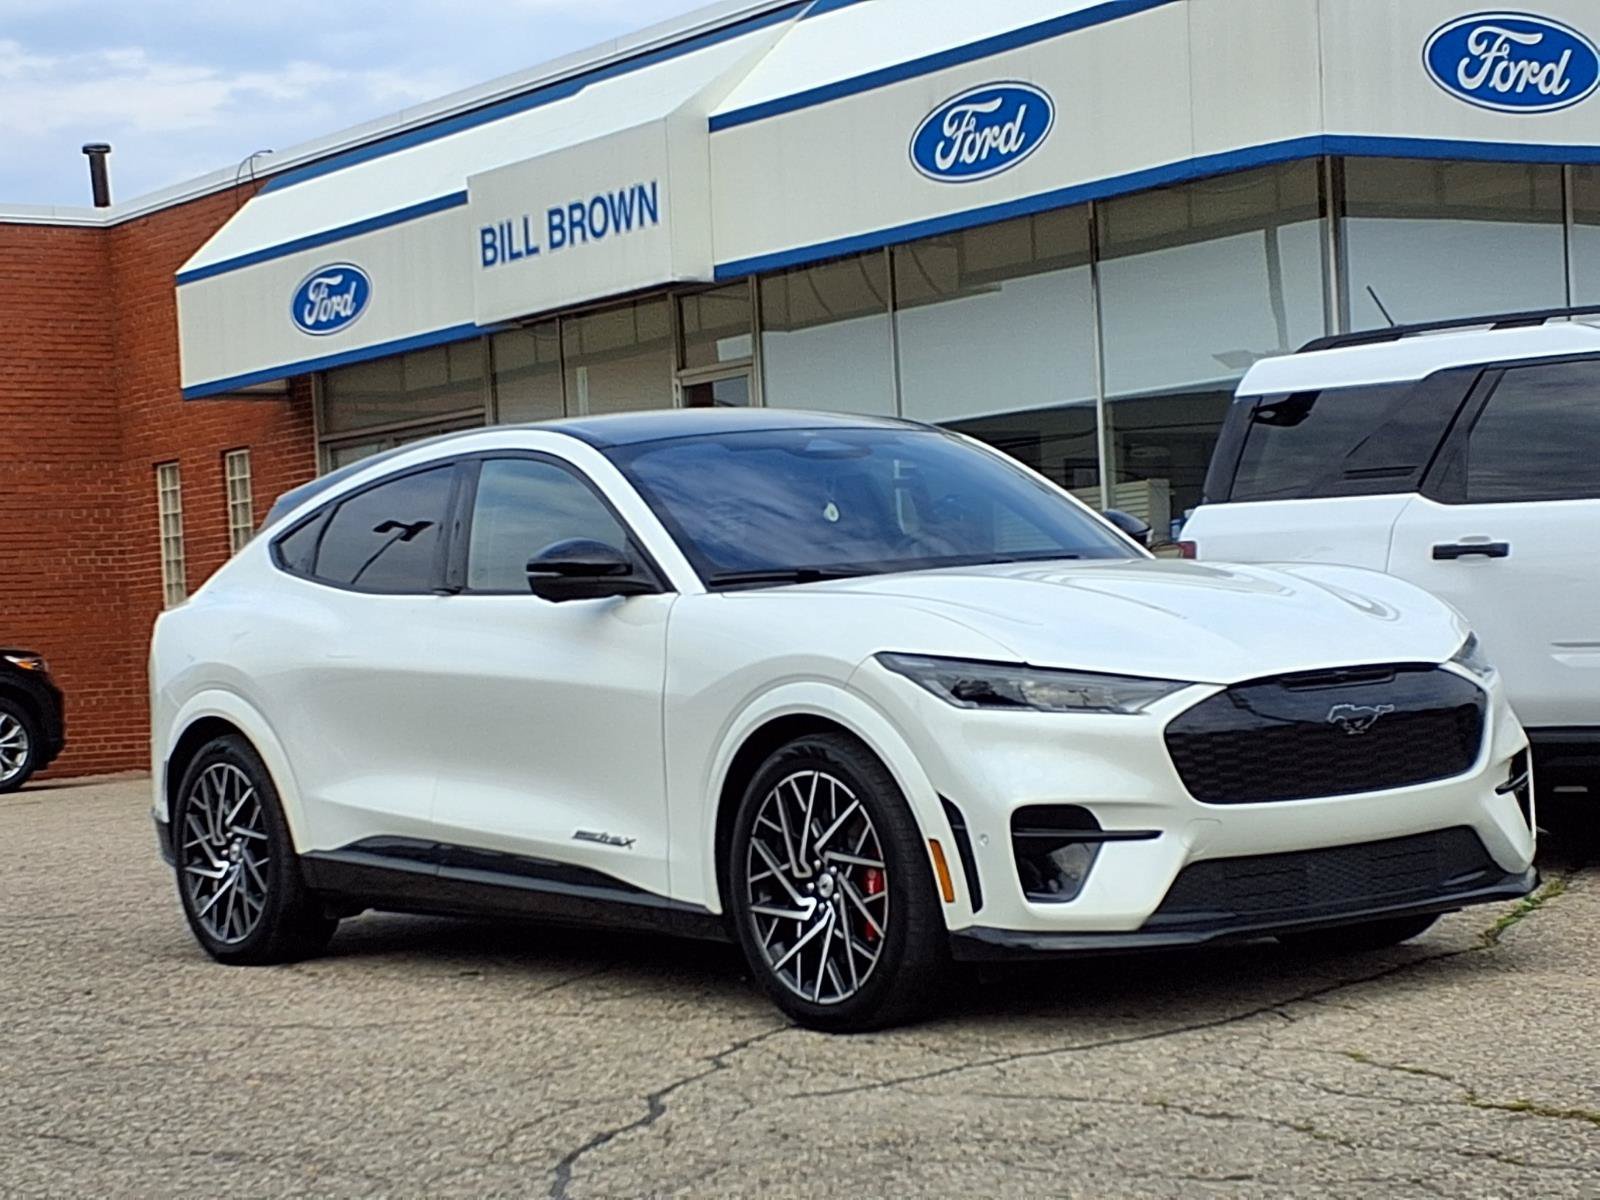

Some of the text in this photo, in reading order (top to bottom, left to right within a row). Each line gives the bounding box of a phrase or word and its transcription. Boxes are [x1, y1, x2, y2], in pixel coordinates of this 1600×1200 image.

[1457, 26, 1572, 95] Ford
[935, 97, 1027, 170] Ford
[480, 181, 658, 267] BILL BROWN
[304, 275, 356, 326] Ford
